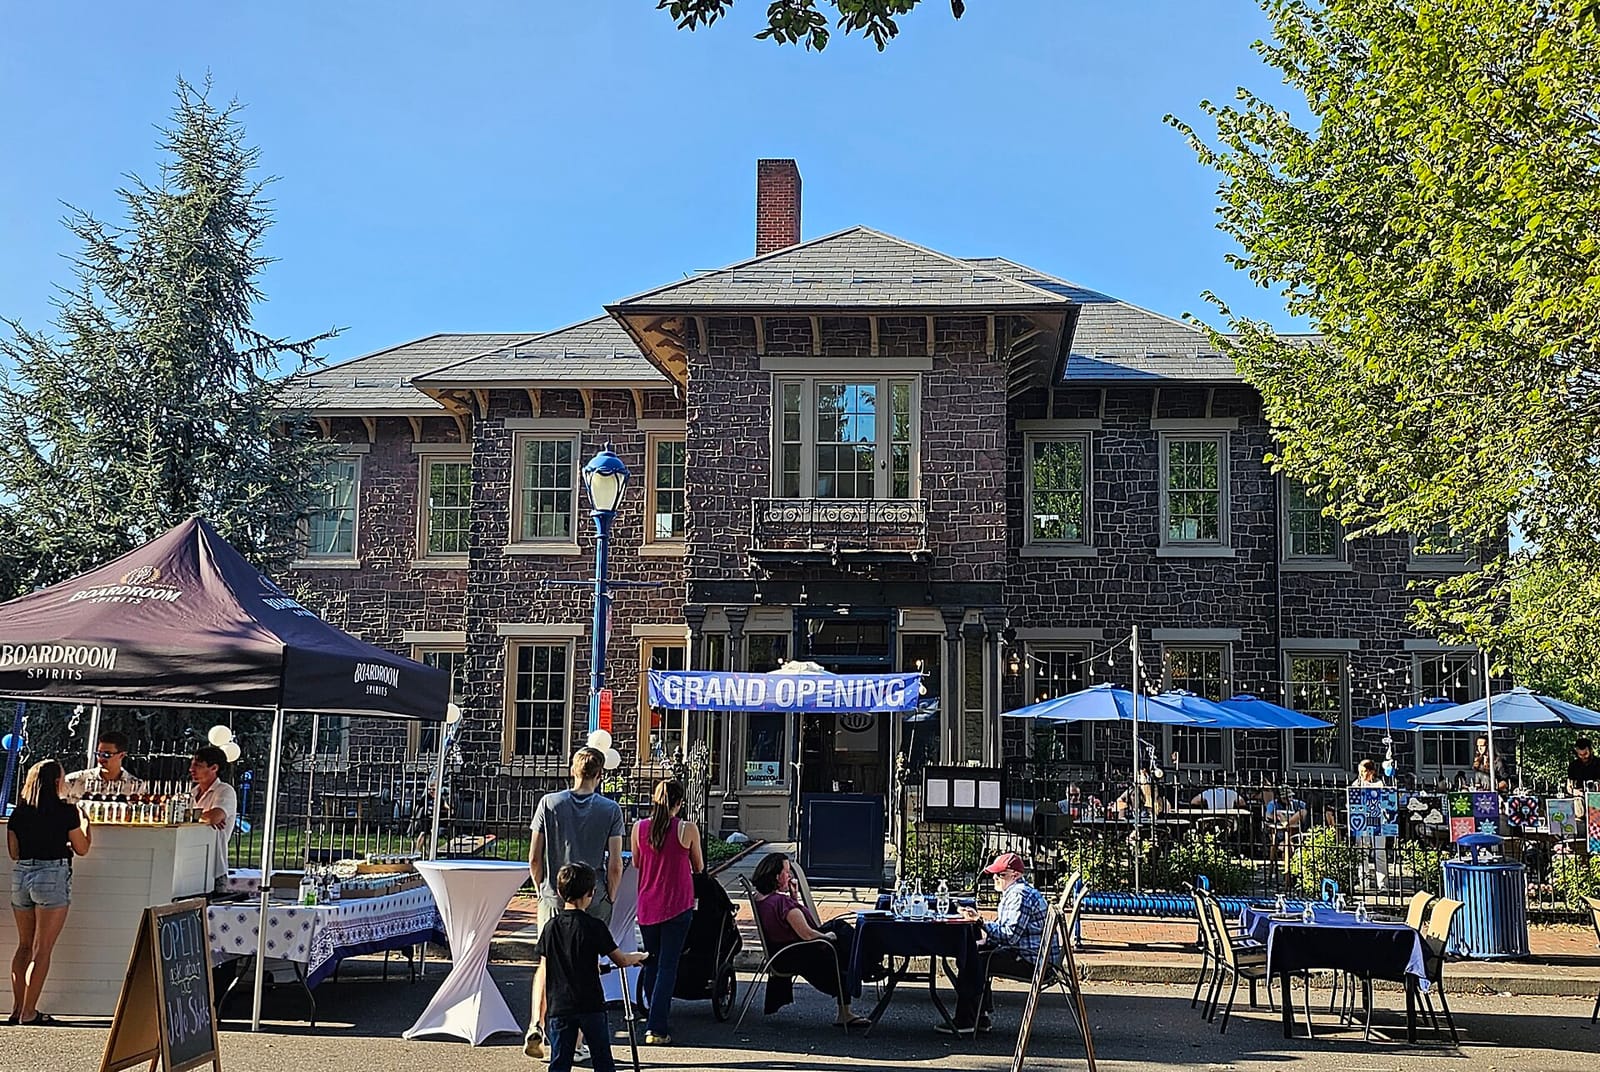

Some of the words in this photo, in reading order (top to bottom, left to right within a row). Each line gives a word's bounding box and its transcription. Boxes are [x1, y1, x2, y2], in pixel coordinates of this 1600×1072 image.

[68, 585, 182, 602] BOARDROOM
[89, 596, 143, 605] SPIRITS
[0, 644, 117, 670] BOARDROOM
[27, 668, 83, 680] SPIRITS
[354, 663, 400, 689] BOARDROOM
[366, 685, 388, 697] SPIRITS
[663, 677, 766, 707] GRAND
[775, 677, 905, 708] OPENING
[161, 914, 200, 961] OPEN
[170, 962, 182, 981] ask
[167, 998, 189, 1046] Jello
